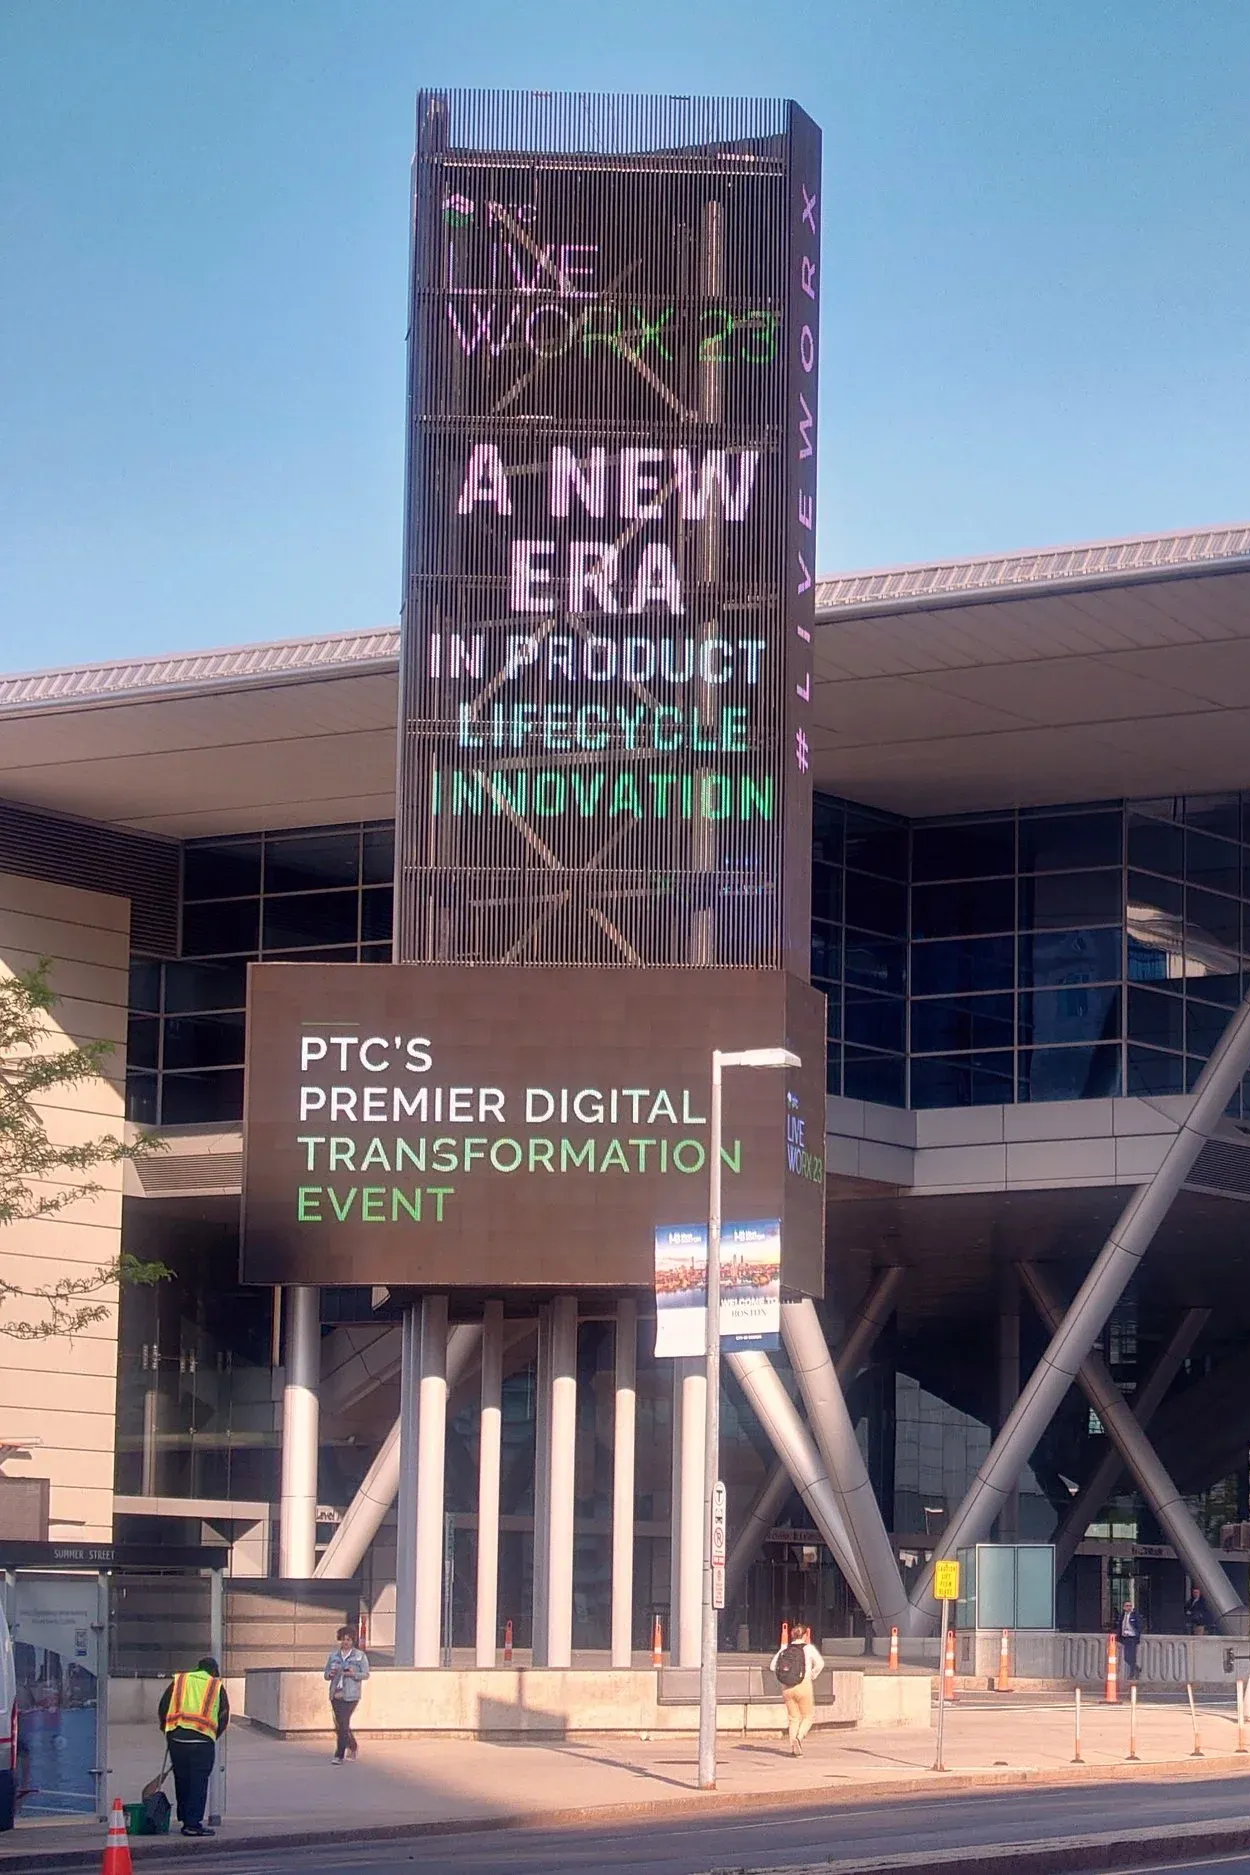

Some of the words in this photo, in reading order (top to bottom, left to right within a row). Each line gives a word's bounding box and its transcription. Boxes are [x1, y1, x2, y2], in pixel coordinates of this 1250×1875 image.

[449, 240, 599, 299] LIVE
[447, 301, 673, 362] WORX
[699, 308, 777, 364] 23
[457, 443, 513, 517] A
[551, 446, 760, 523] NEW
[510, 539, 686, 616] ERA
[430, 632, 484, 680] IN
[505, 634, 767, 686] PRODUCT
[458, 702, 750, 753] LIFECYCLE
[431, 770, 775, 821] INNOVATION
[301, 1036, 433, 1073] PTC'S
[300, 1086, 506, 1123] PREMIER
[525, 1087, 707, 1125] DIGITAL
[297, 1136, 741, 1174] TRANSFORMATION
[298, 1187, 455, 1222] EVENT
[53, 1549, 84, 1560] SUMMER
[88, 1549, 116, 1561] STREET
